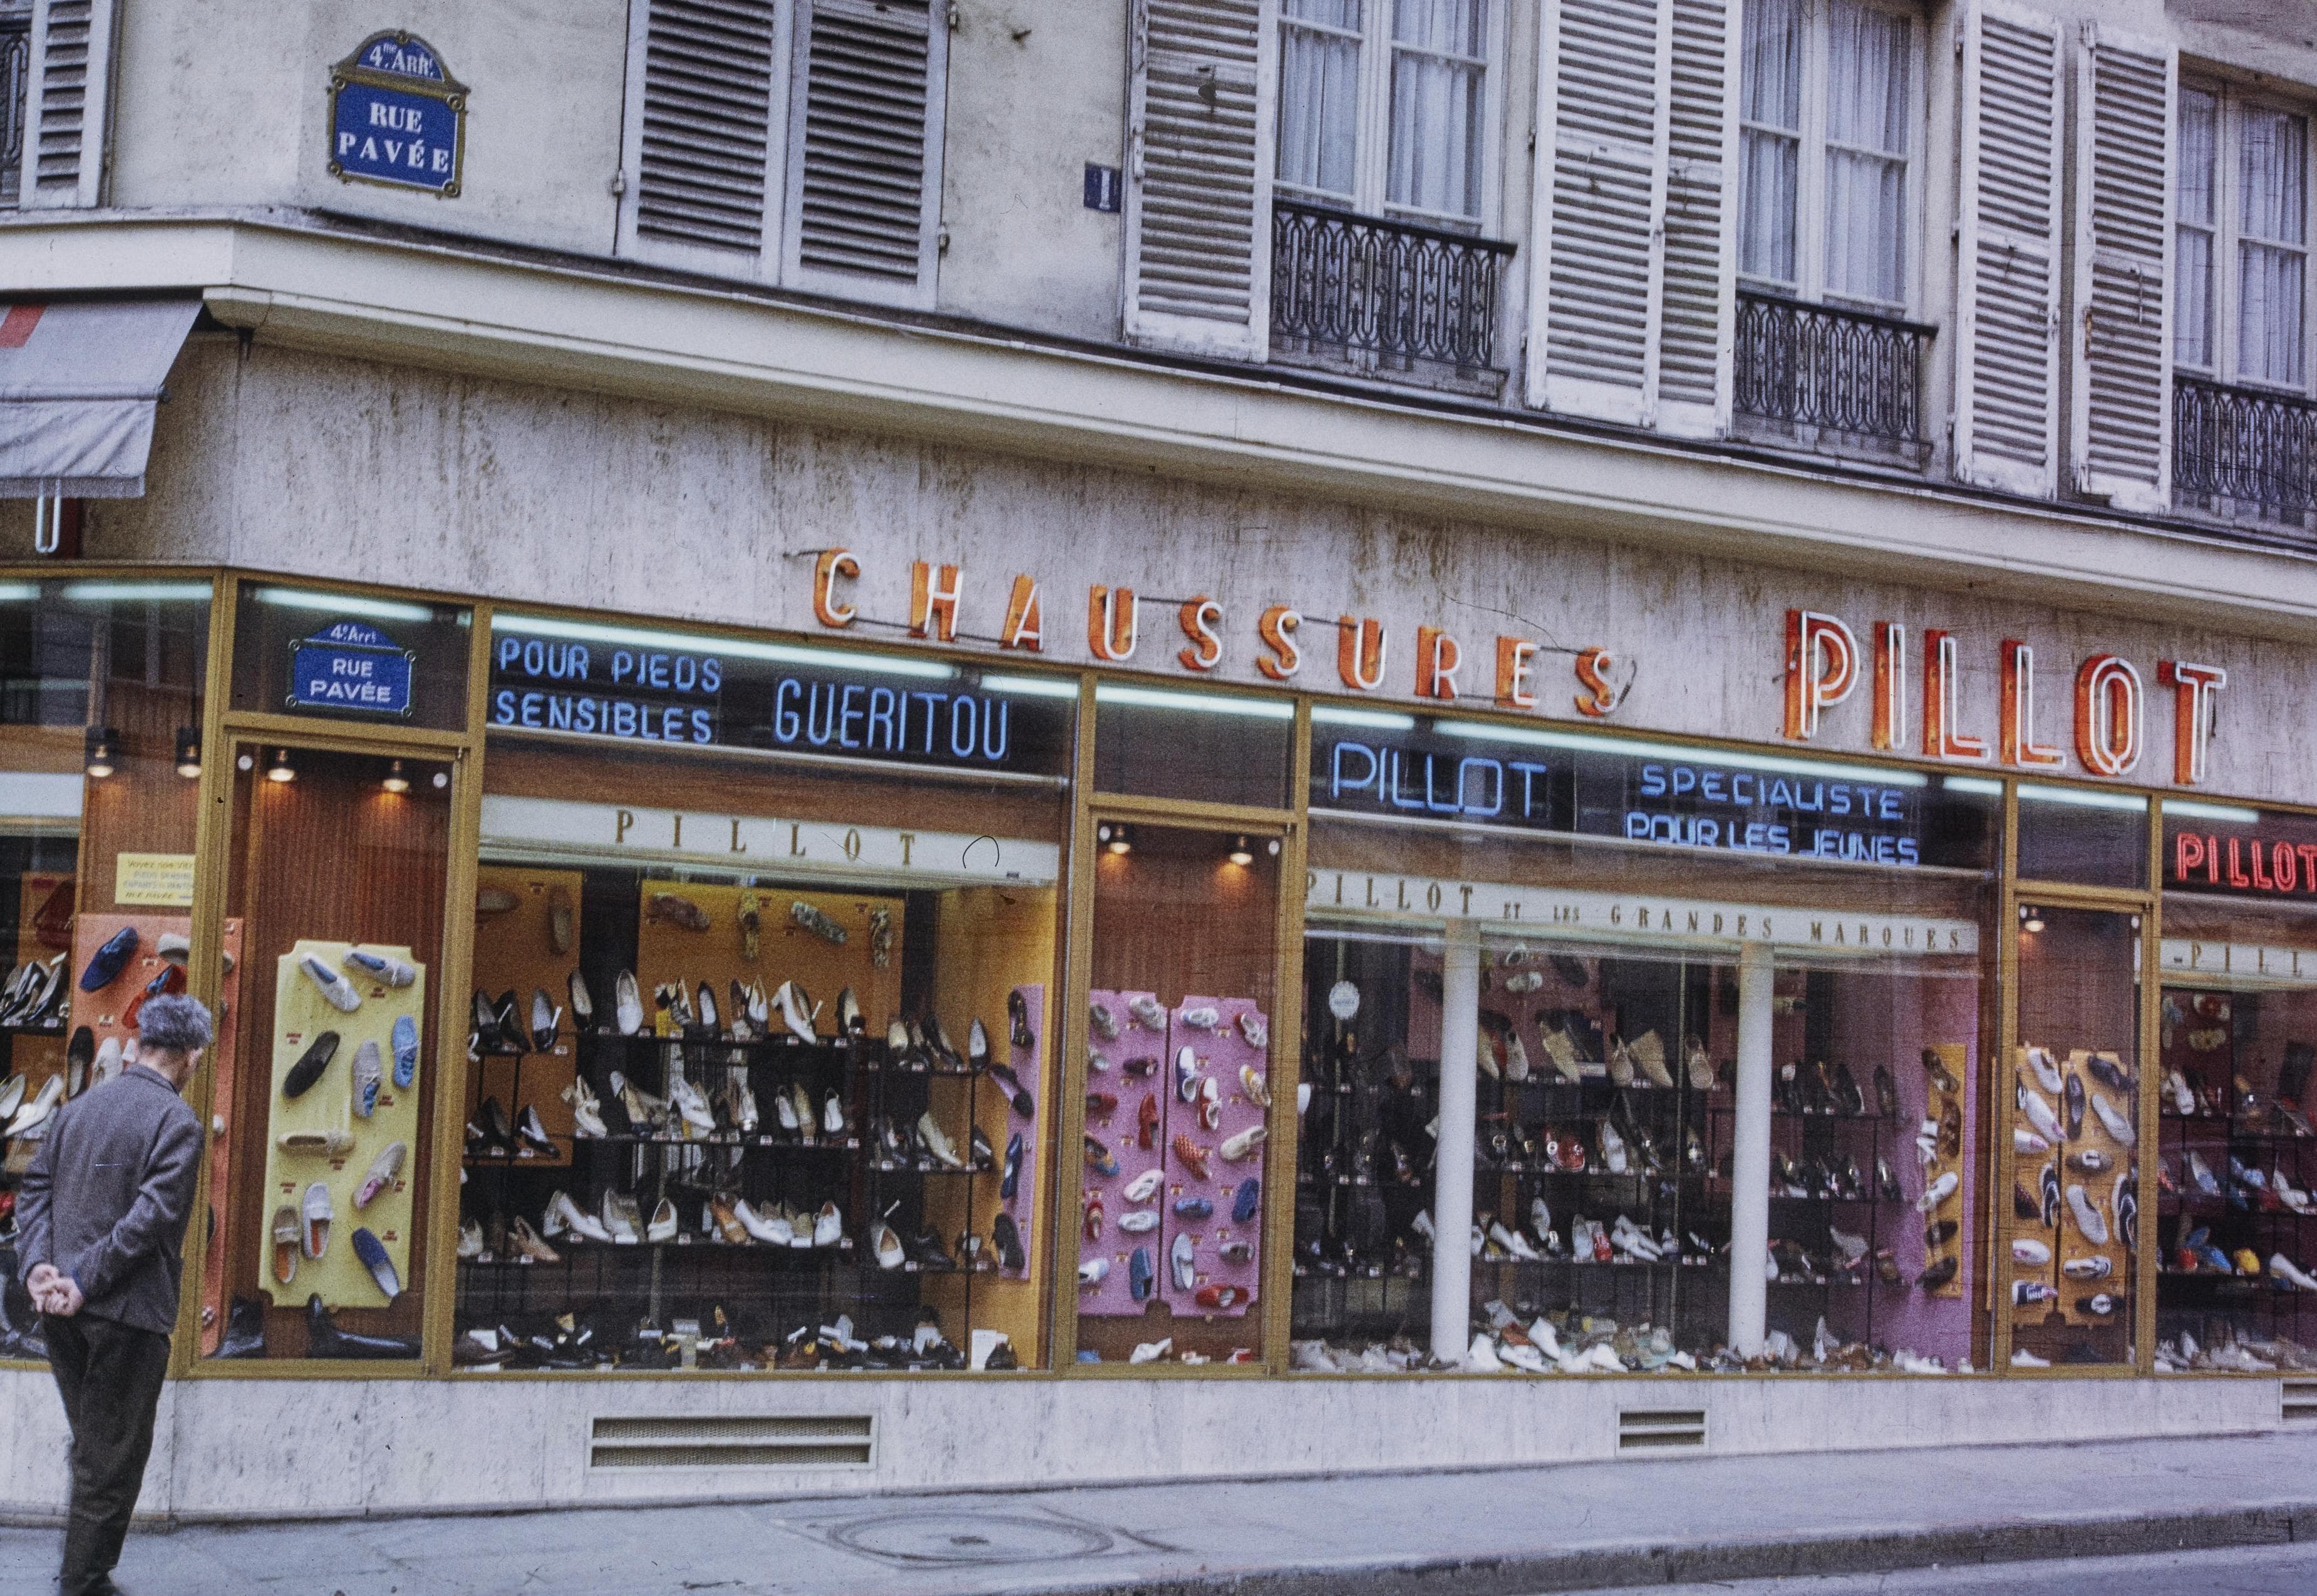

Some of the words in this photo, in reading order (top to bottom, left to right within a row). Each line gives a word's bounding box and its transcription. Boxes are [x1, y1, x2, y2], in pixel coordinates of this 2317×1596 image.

[369, 101, 422, 134] RUE
[339, 131, 449, 173] PAVÉE
[814, 547, 1618, 716] CHAUSSURES
[311, 679, 391, 703] PAVÉE
[333, 658, 373, 677] RUE
[499, 637, 589, 681] POUR
[612, 650, 722, 693] PIEDS
[495, 690, 712, 744] SENSIBLES
[775, 678, 1008, 761] GUERITOU
[1785, 608, 2227, 785] PILLOT
[1333, 742, 1547, 818] PILLOT
[1641, 765, 1903, 820] SPECIALISTE
[615, 809, 915, 865] PILLOT
[1626, 811, 1720, 847] POUR
[1728, 821, 1791, 855] LES
[1798, 828, 1919, 867] JEUNES
[2176, 831, 2317, 893] PILLOT
[1304, 871, 1473, 915] PILLOT
[1504, 901, 1521, 920] ET
[1554, 904, 1580, 922] LES
[1611, 904, 1772, 939] GRANDES
[1810, 921, 1959, 950] MARQUES
